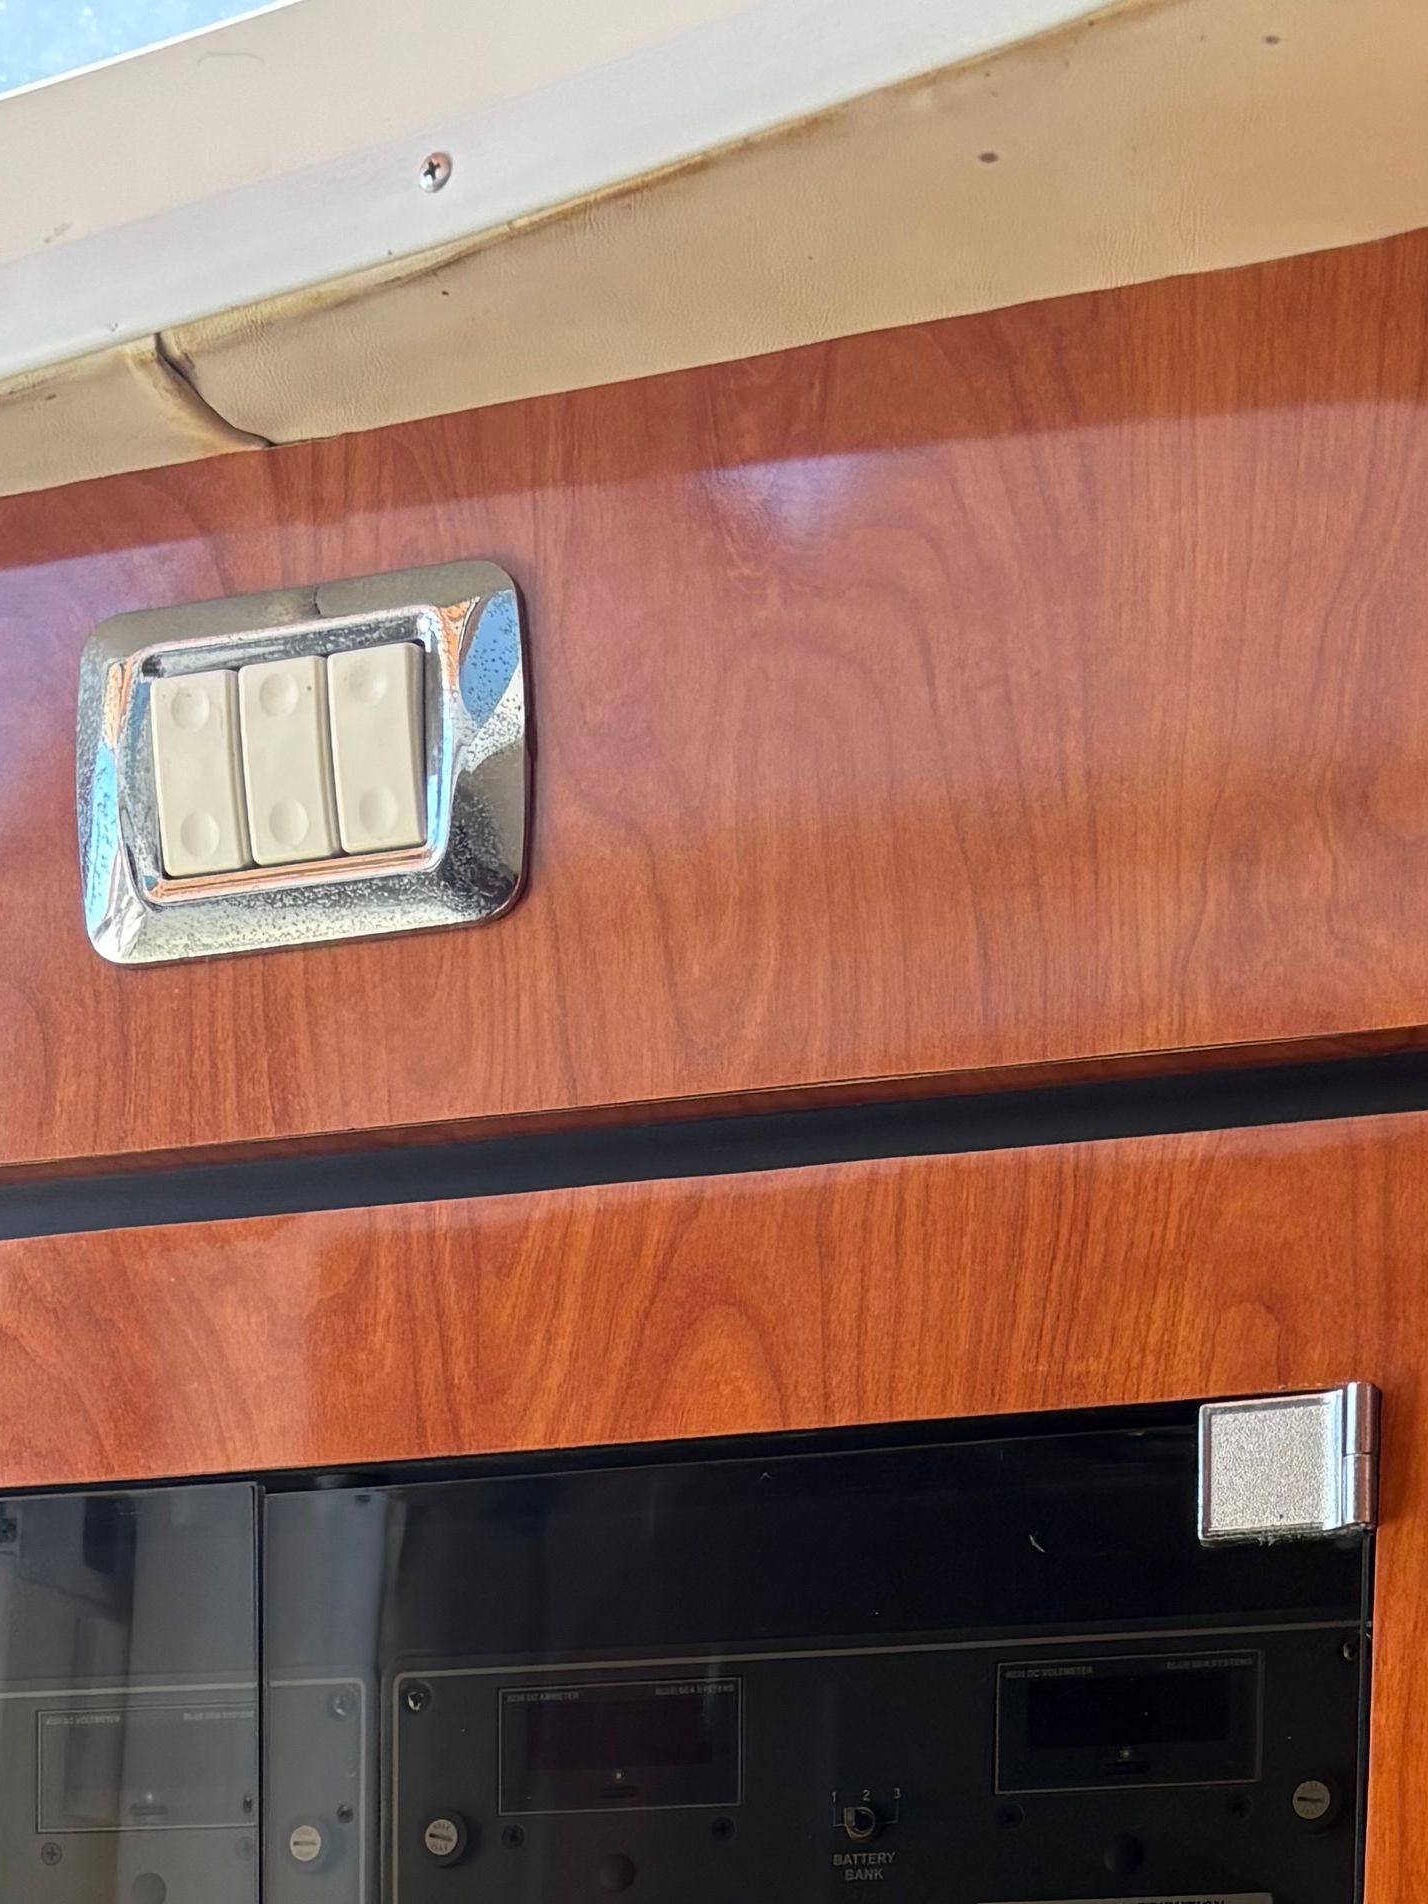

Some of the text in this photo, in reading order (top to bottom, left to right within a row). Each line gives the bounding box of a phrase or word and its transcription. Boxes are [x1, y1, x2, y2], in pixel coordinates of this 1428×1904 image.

[862, 1789, 870, 1801] 2
[893, 1788, 901, 1799] 3
[833, 1852, 896, 1867] BATTERY
[845, 1867, 884, 1881] BANK
